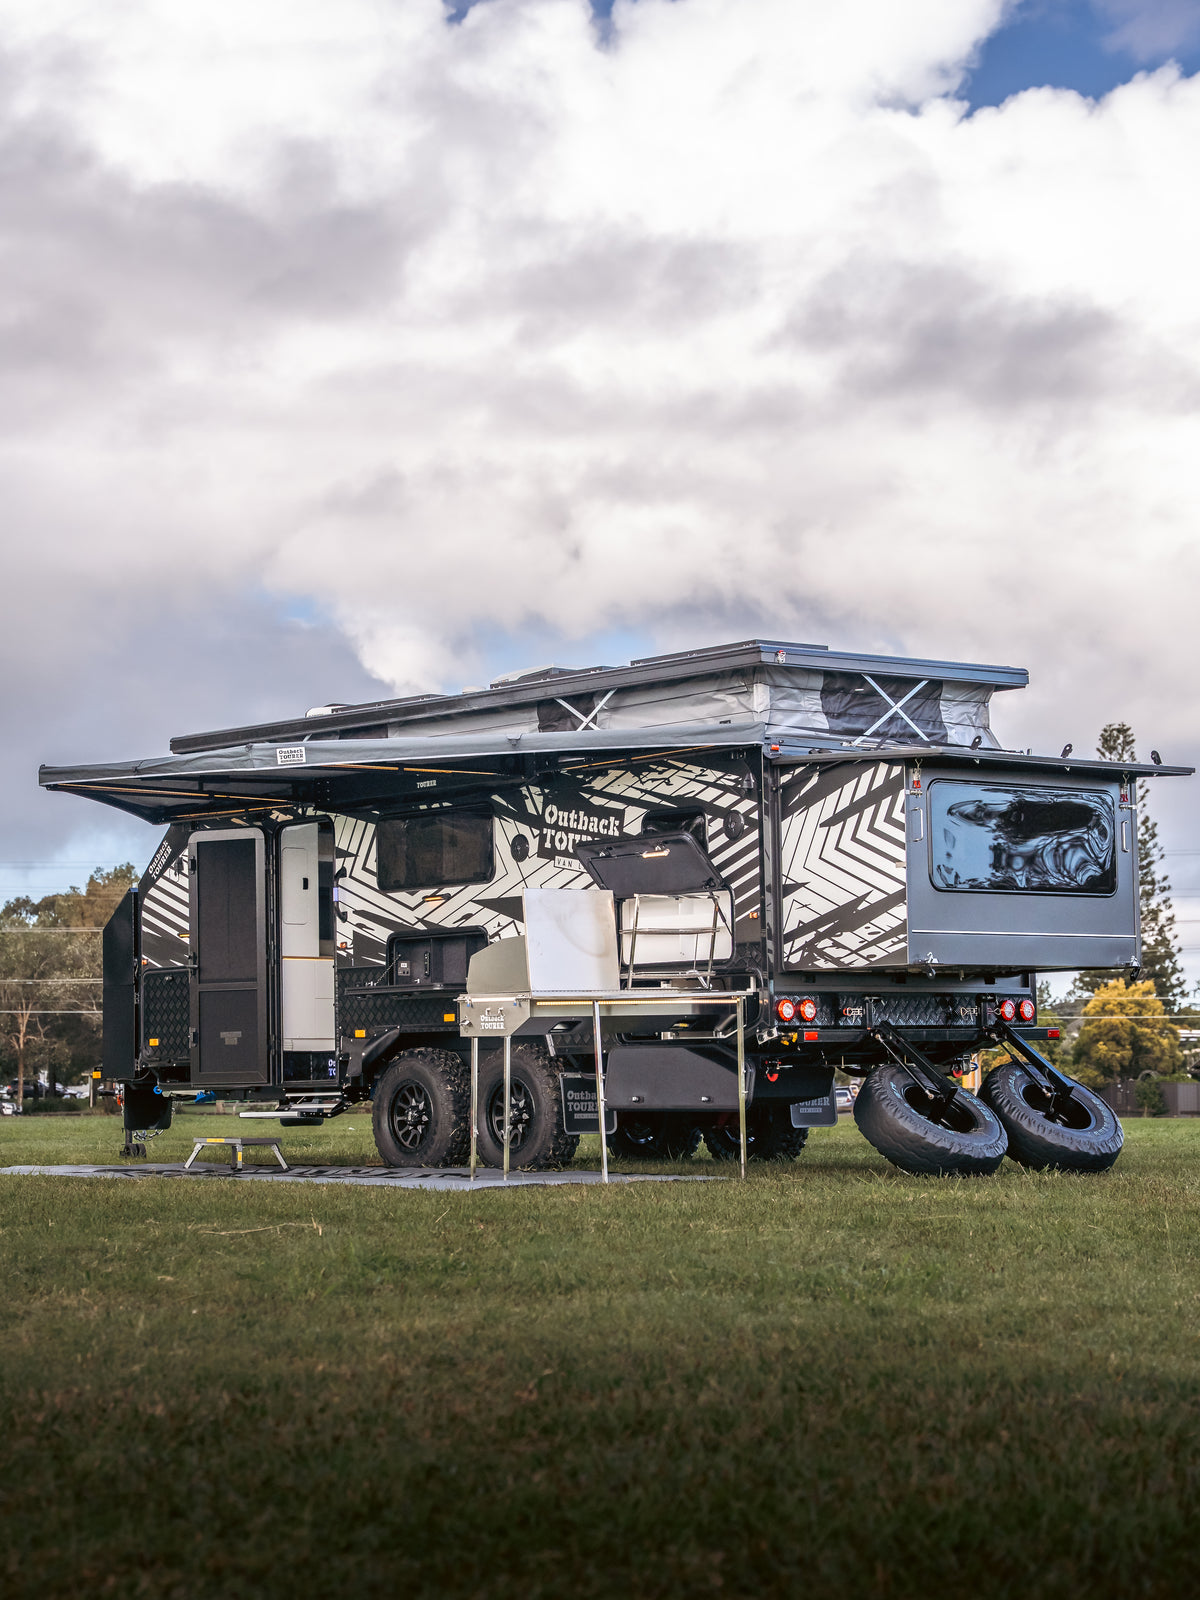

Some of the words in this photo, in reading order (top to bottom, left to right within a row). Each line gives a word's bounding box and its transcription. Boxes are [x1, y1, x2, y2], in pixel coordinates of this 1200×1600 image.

[544, 804, 620, 836] Outback
[543, 828, 600, 853] TOU
[148, 840, 168, 874] Outback
[151, 846, 172, 880] TOURER
[557, 858, 573, 868] VAN
[480, 1022, 505, 1030] TOURER
[567, 1090, 597, 1100] Outba
[567, 1101, 602, 1111] TOUR
[795, 1097, 831, 1106] URER
